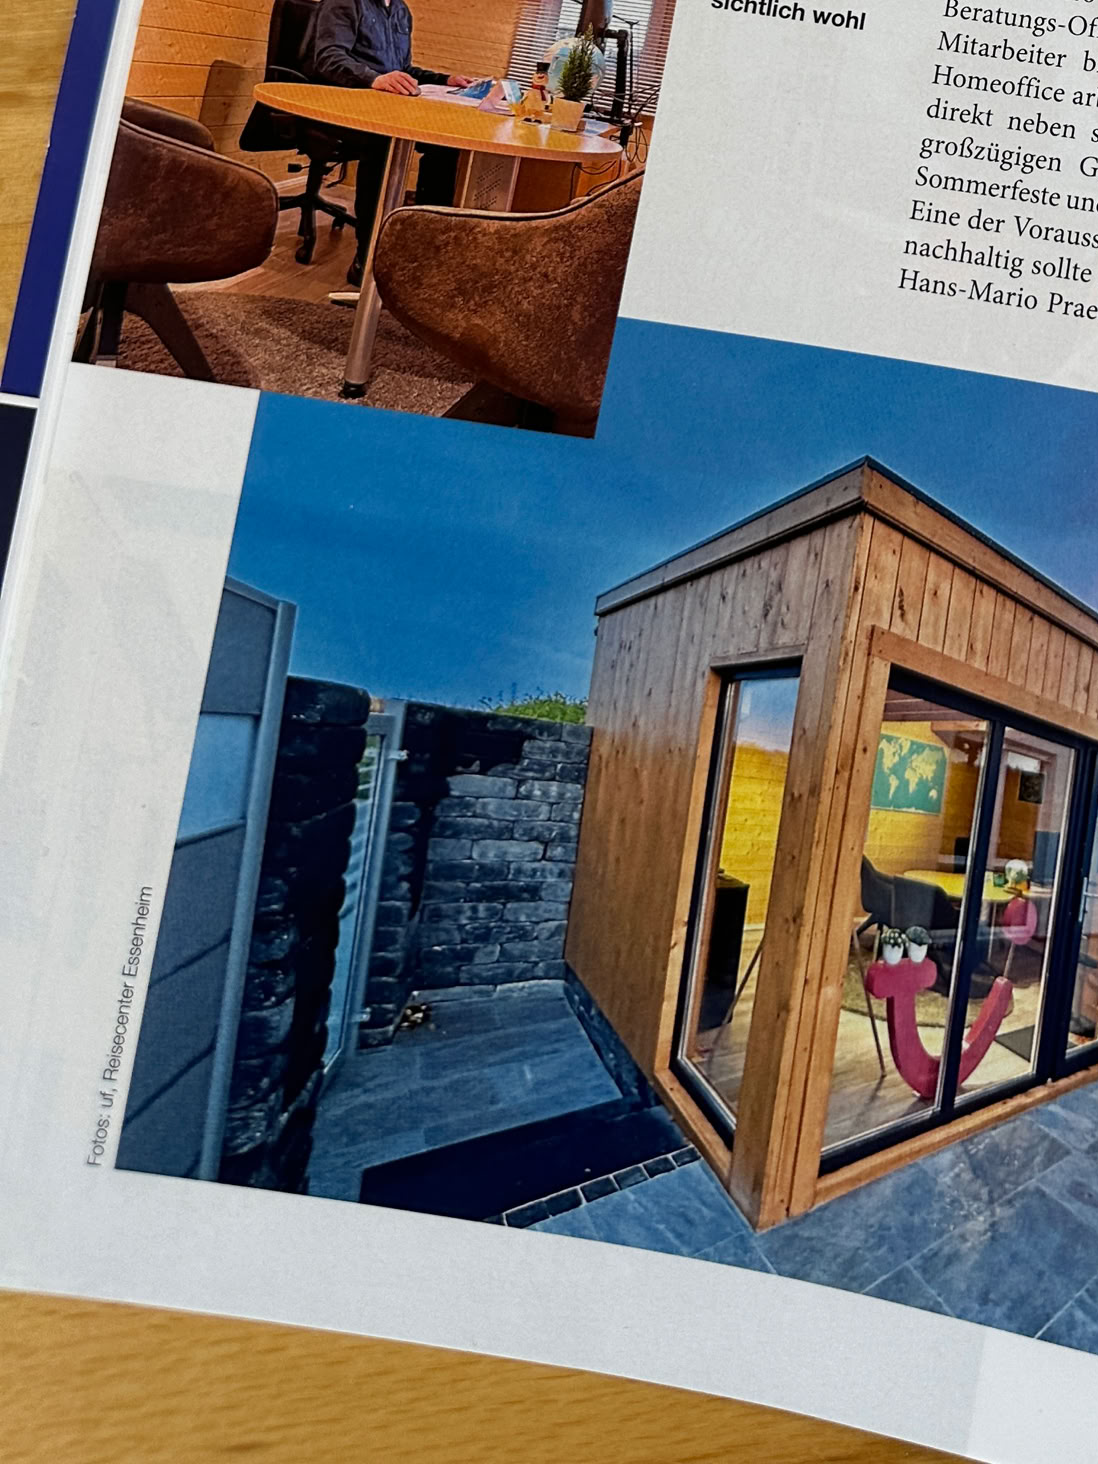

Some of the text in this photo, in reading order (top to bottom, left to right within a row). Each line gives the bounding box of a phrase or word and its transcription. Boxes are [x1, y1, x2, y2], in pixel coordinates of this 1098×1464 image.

[813, 10, 866, 30] wohl
[909, 200, 960, 226] Eine
[968, 208, 1005, 233] der
[86, 1112, 111, 1167] Fotos:
[101, 982, 134, 1081] Reisecenter
[121, 887, 151, 977] Essenheim
